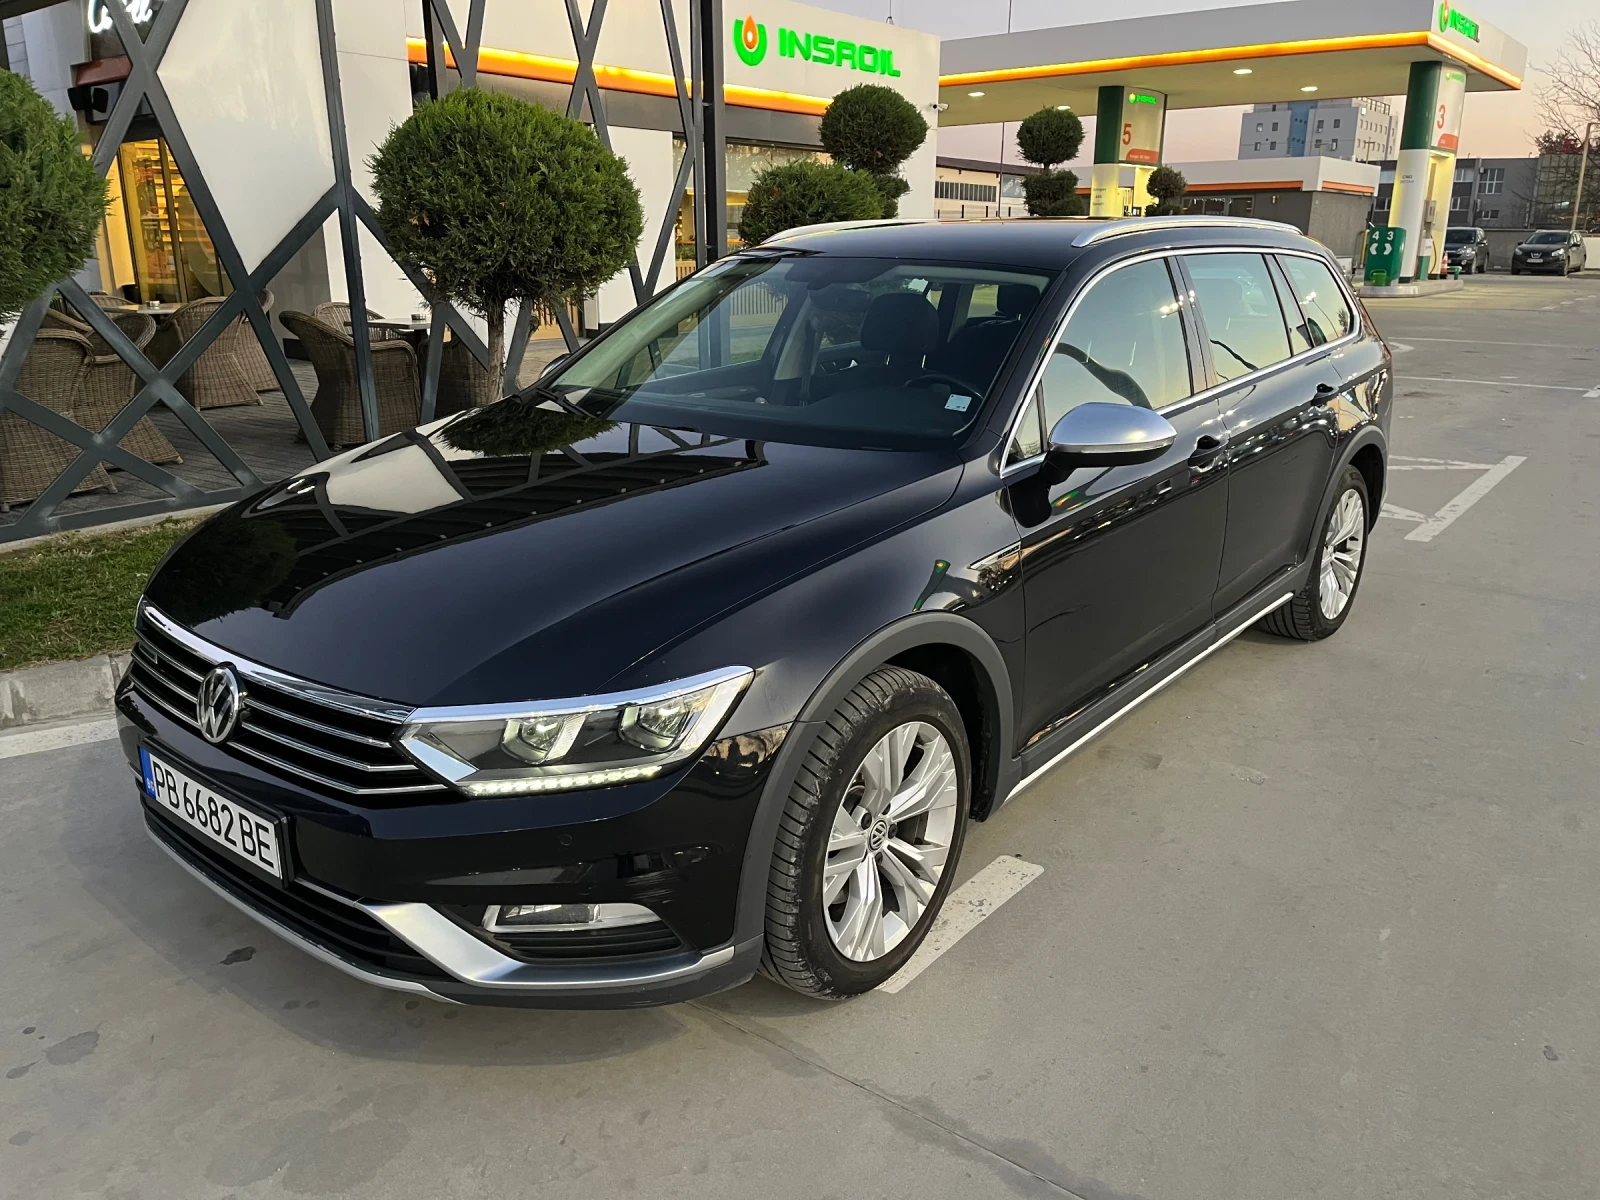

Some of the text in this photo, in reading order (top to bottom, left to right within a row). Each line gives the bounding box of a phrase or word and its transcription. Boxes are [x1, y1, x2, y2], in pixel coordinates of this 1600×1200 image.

[1437, 104, 1446, 129] 3
[1122, 123, 1132, 145] 5
[1372, 231, 1394, 240] 4 3
[152, 760, 275, 869] PB 6682 BE
